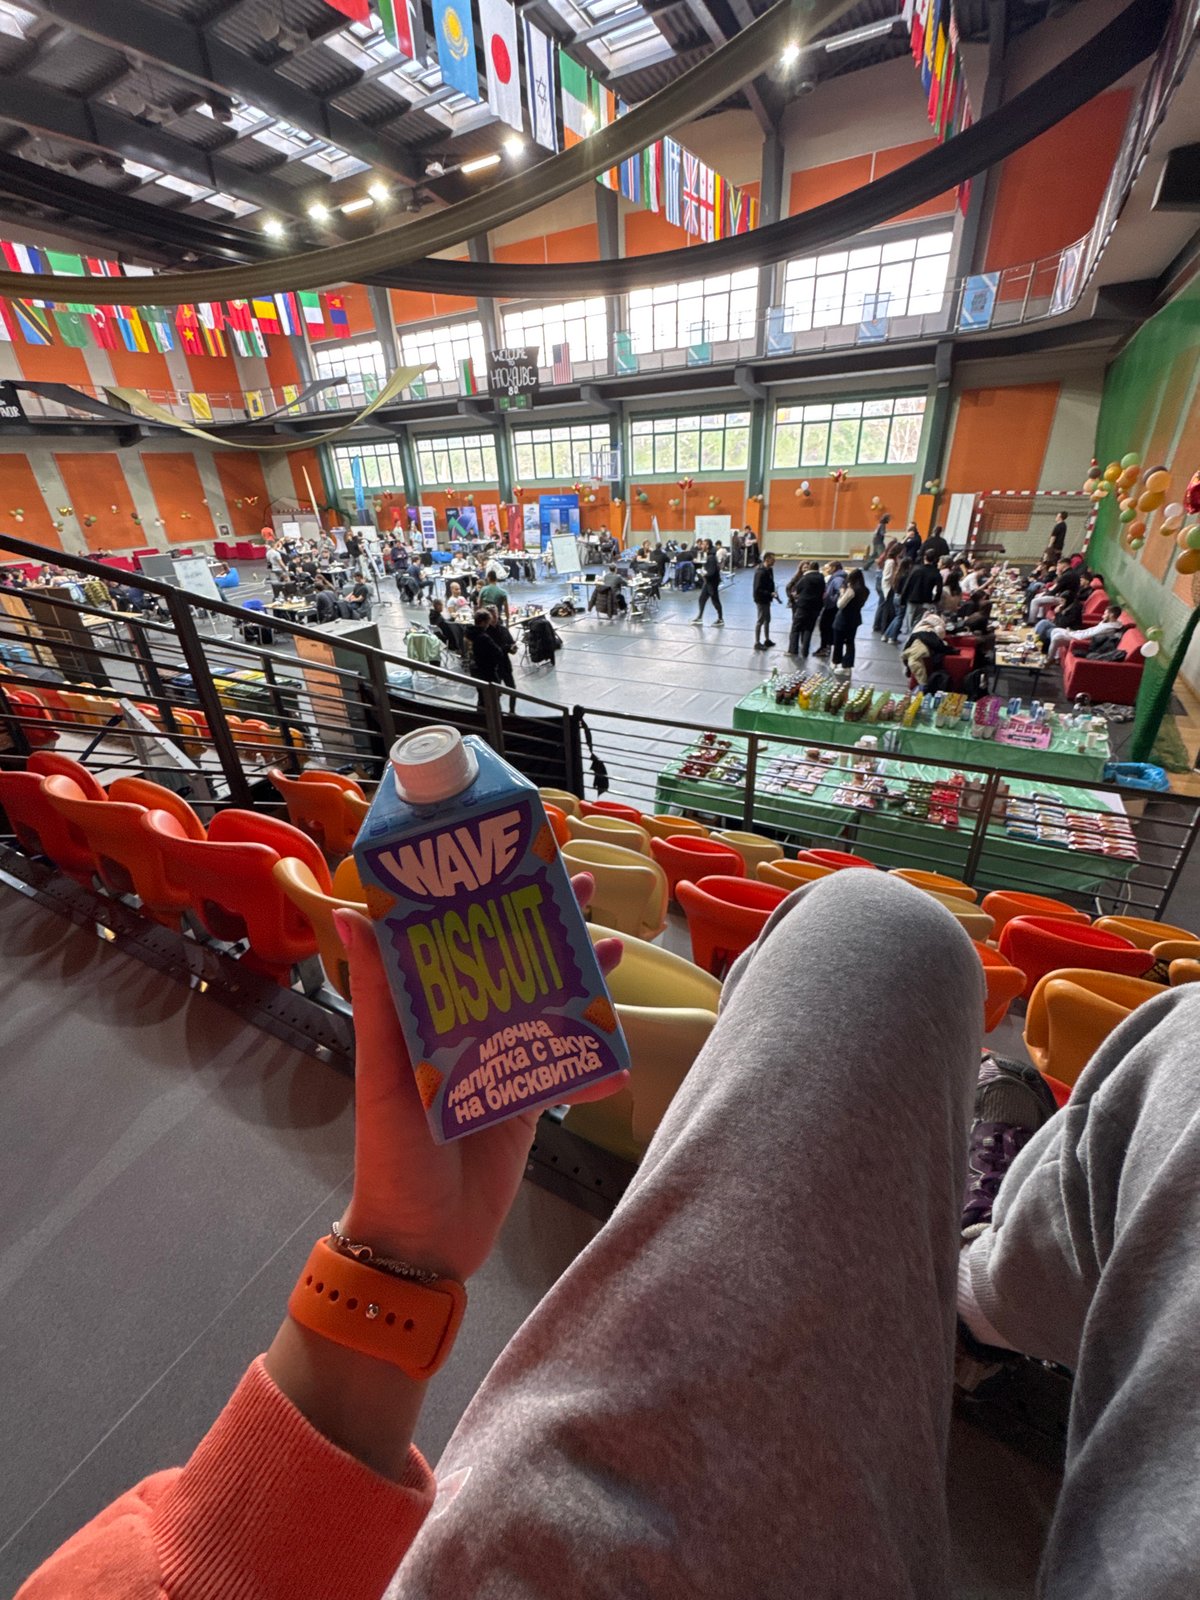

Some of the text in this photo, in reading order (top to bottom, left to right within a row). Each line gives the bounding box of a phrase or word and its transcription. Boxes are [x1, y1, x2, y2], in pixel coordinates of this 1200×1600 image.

[491, 349, 528, 362] WELCOME
[378, 810, 521, 897] WAVE
[407, 884, 564, 1035] BISCUIT
[448, 1046, 531, 1107] напитка
[548, 1035, 600, 1059] вкус
[479, 1020, 553, 1063] млечна
[455, 1051, 602, 1124] на бисквитка
